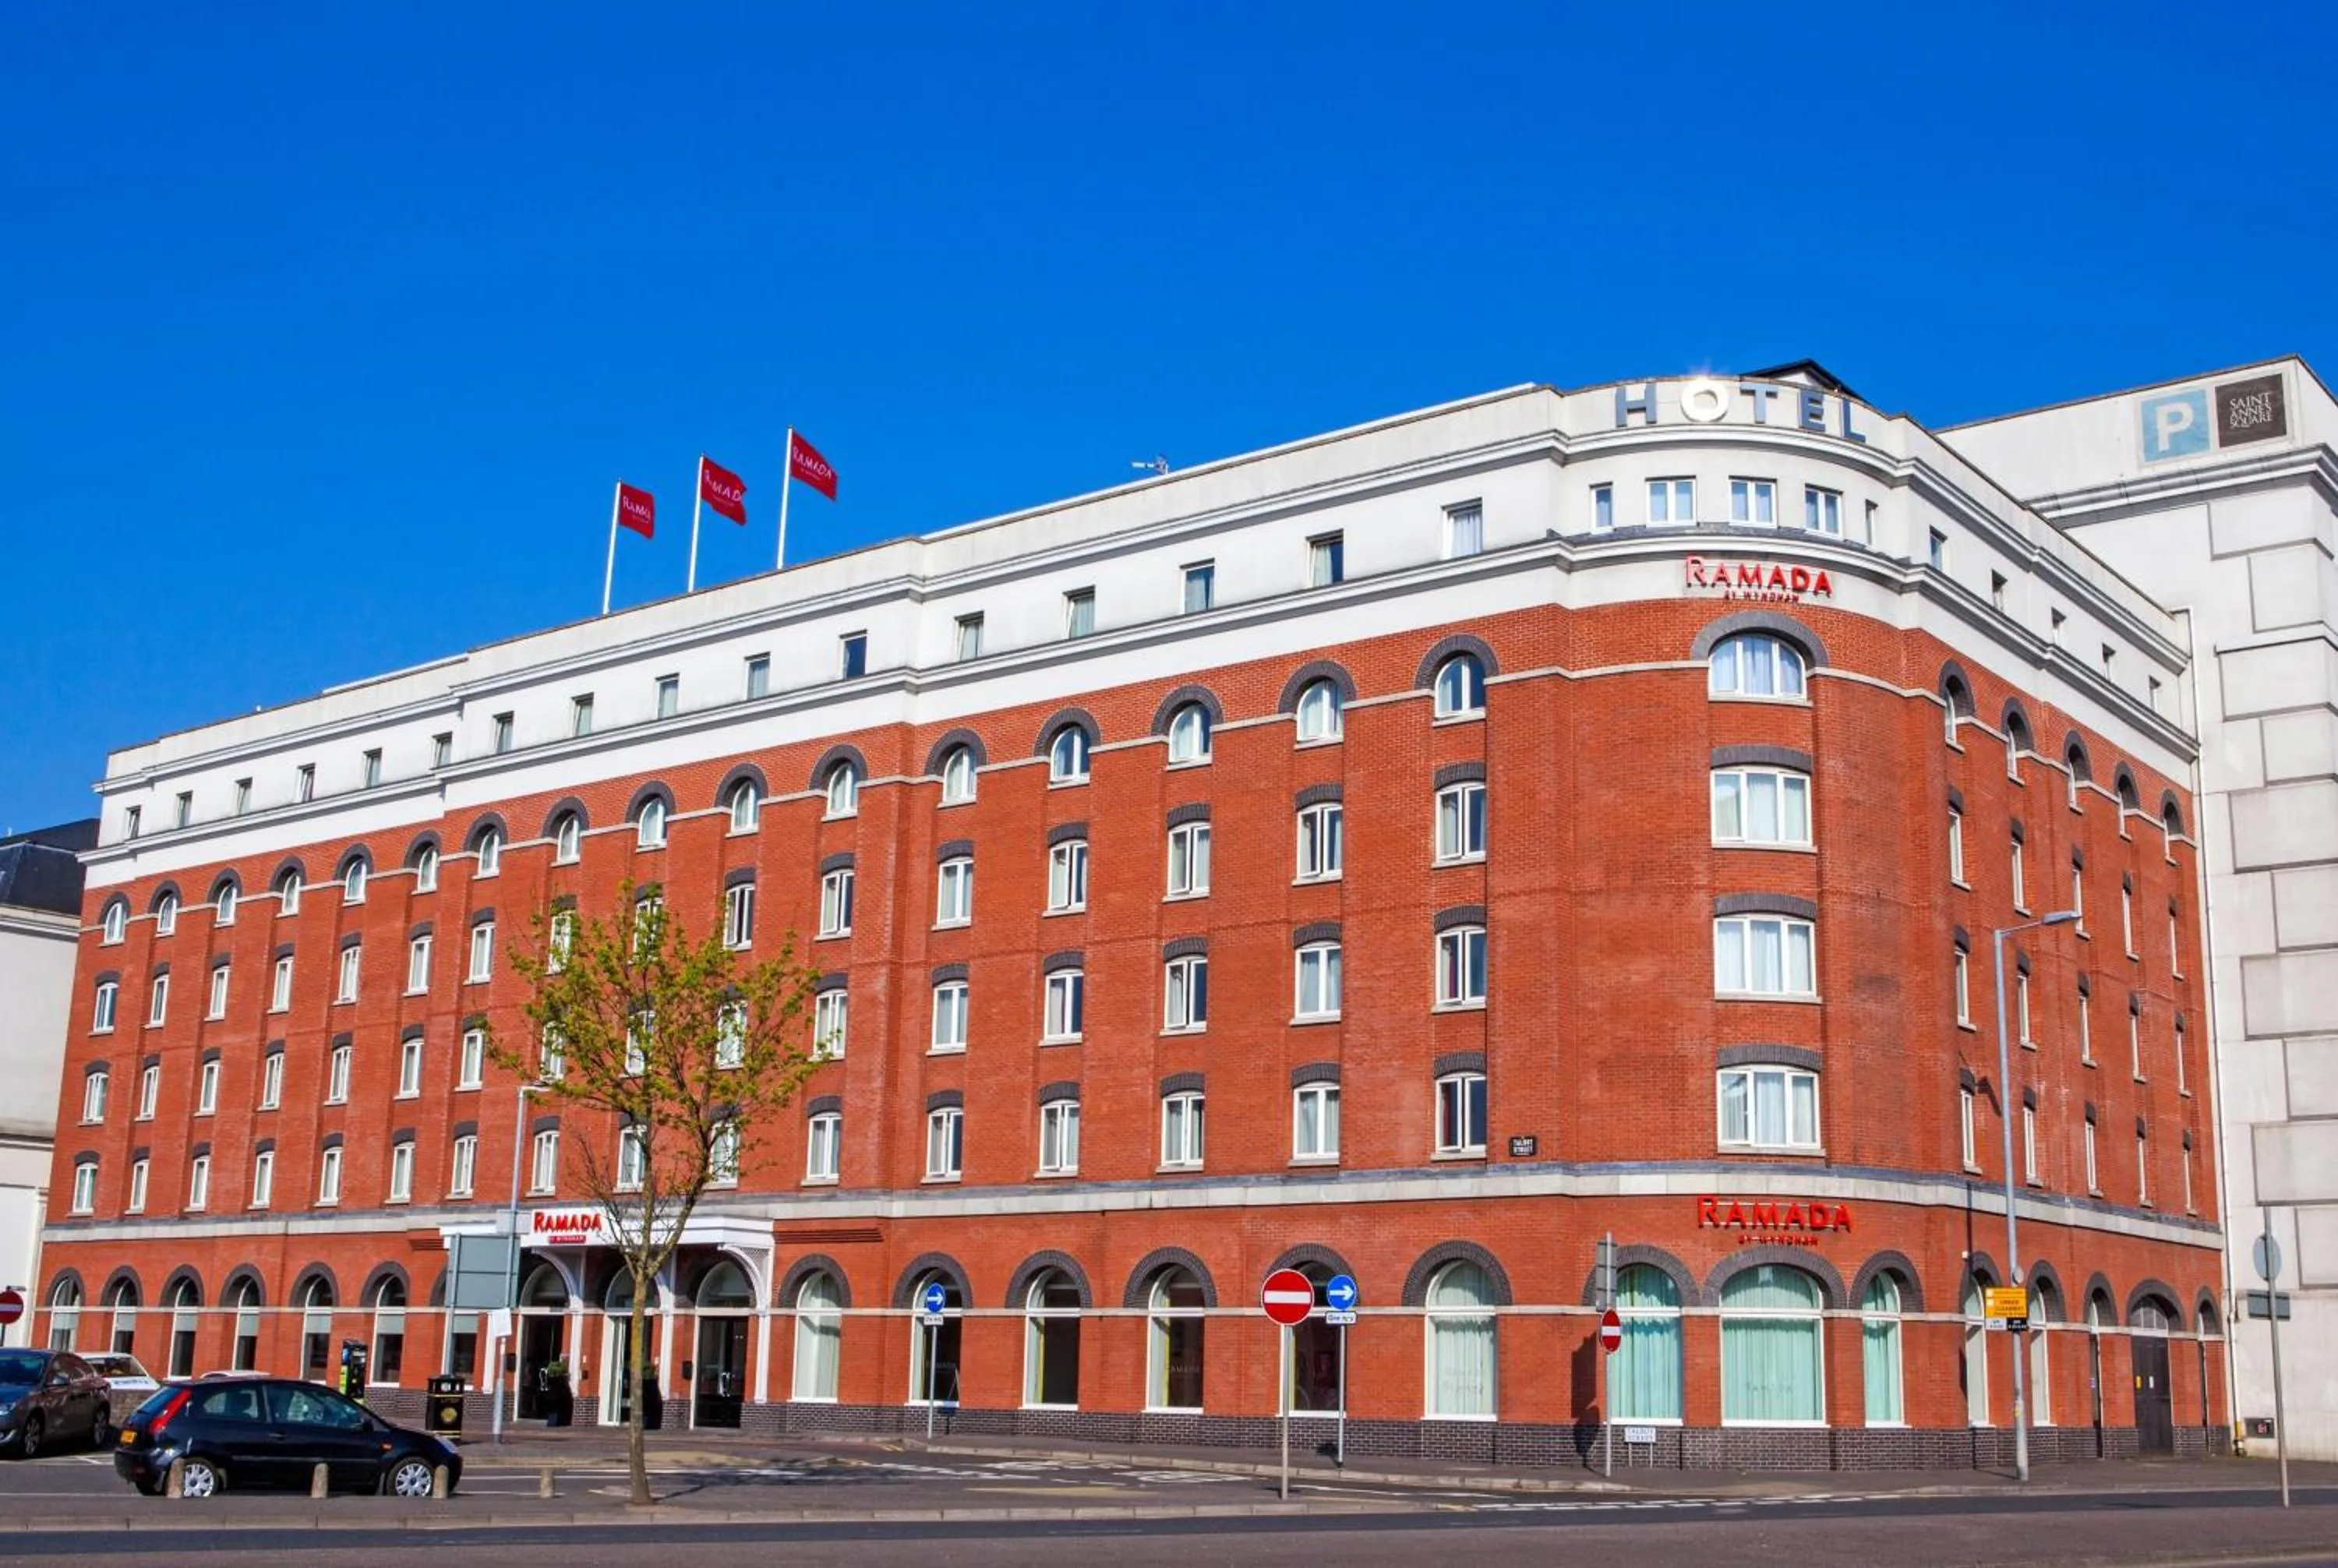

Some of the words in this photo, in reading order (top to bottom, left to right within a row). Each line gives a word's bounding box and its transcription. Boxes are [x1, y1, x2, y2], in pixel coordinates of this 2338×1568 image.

[1615, 380, 1867, 443] HOTEL
[2230, 392, 2270, 410] SAINT
[2156, 402, 2195, 451] P
[1686, 555, 1833, 599] RAMADA
[534, 1212, 602, 1233] RAMADA
[1697, 1195, 1852, 1233] RAMADA
